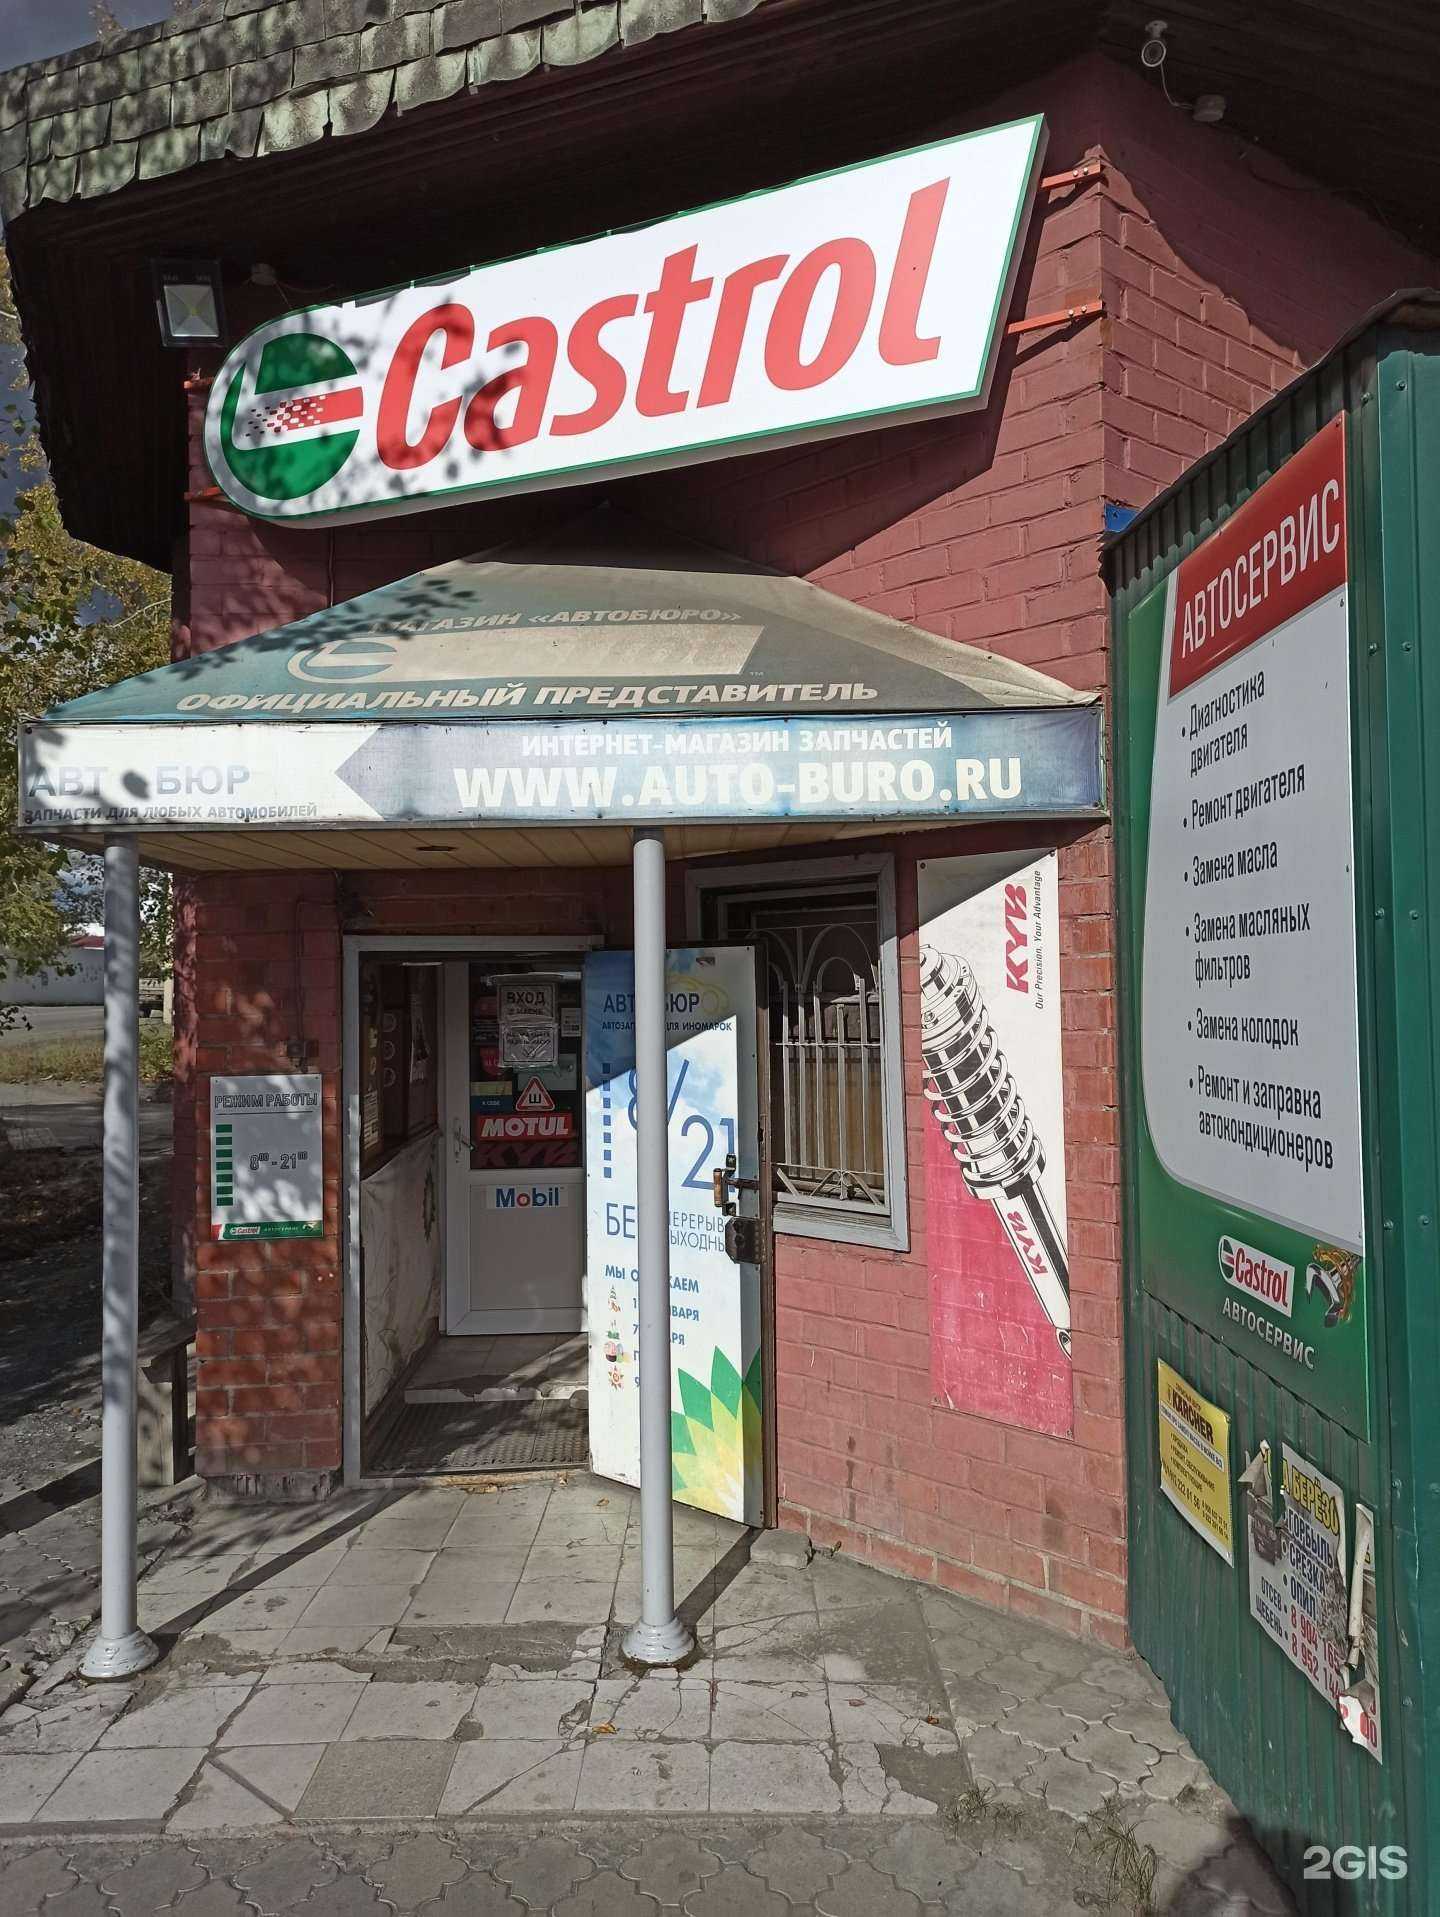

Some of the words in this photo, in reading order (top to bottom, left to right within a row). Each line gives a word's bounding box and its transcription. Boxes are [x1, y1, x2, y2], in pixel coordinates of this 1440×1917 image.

[376, 176, 950, 470] Castrol
[1181, 479, 1340, 658] АВТОСЕРВИС
[177, 682, 529, 713] ОФИЦИАЛЬНЫЙ
[533, 683, 878, 708] ПРЕДСТАВИТЕЛЬ
[1190, 671, 1265, 741] Диагностика
[522, 729, 790, 757] ИНТЕРНЕТ-МАГАЗИН
[799, 720, 953, 752] ЗАПЧАСТЕЙ
[1190, 723, 1248, 778] двигателя
[454, 757, 1023, 808] WWW.AUTO-BURO.RU
[1192, 791, 1233, 830] Ремонт
[1235, 763, 1305, 819] двигателя
[26, 806, 102, 823] ЗАПЧАСТИ
[105, 806, 138, 820] ДЛЯ
[143, 805, 201, 819] ЛЮБЫХ
[207, 802, 318, 820] АВТОМОБИЛЕЙ
[1193, 851, 1234, 887] Замена
[1238, 841, 1278, 877] масла
[1033, 870, 1042, 918] Advantage
[1004, 883, 1029, 993] KYB
[1033, 921, 1042, 942] Your
[1194, 912, 1236, 943] Замена
[1239, 902, 1311, 938] масляных
[1034, 947, 1044, 989] Precision,
[1195, 951, 1251, 989] фильтров
[506, 991, 546, 1006] ВХОД
[1035, 998, 1044, 1010] Our
[683, 1021, 733, 1032] ИНОМАРОК
[1196, 1007, 1239, 1041] Замена
[1241, 1016, 1299, 1050] колодок
[215, 1093, 264, 1109] РЕЖИМ
[265, 1092, 319, 1107] РАБОТЫ
[1198, 1064, 1240, 1103] Ремонт
[1243, 1079, 1250, 1105] и
[1253, 1081, 1322, 1120] заправка
[481, 1116, 569, 1137] MOTUL
[1199, 1109, 1334, 1173] автокондиционеров
[495, 1186, 559, 1208] Mobil
[1007, 1210, 1049, 1275] KYB
[605, 1264, 626, 1280] МЫ
[1235, 1247, 1289, 1308] Castrol
[1222, 1297, 1315, 1370] АВТОСЕРВИС
[1288, 1508, 1335, 1569] ГОРБЫЛЬ
[1289, 1541, 1326, 1595] СРЕЗКА
[1255, 1594, 1284, 1638] ЩЕБЕНЬ
[1261, 1576, 1282, 1612] ОТСЕВ
[1290, 1576, 1317, 1621] ОПИЛ
[1290, 1604, 1297, 1629] 8
[1300, 1611, 1319, 1651] 904
[1291, 1633, 1298, 1657] 8
[1301, 1644, 1320, 1682] 952
